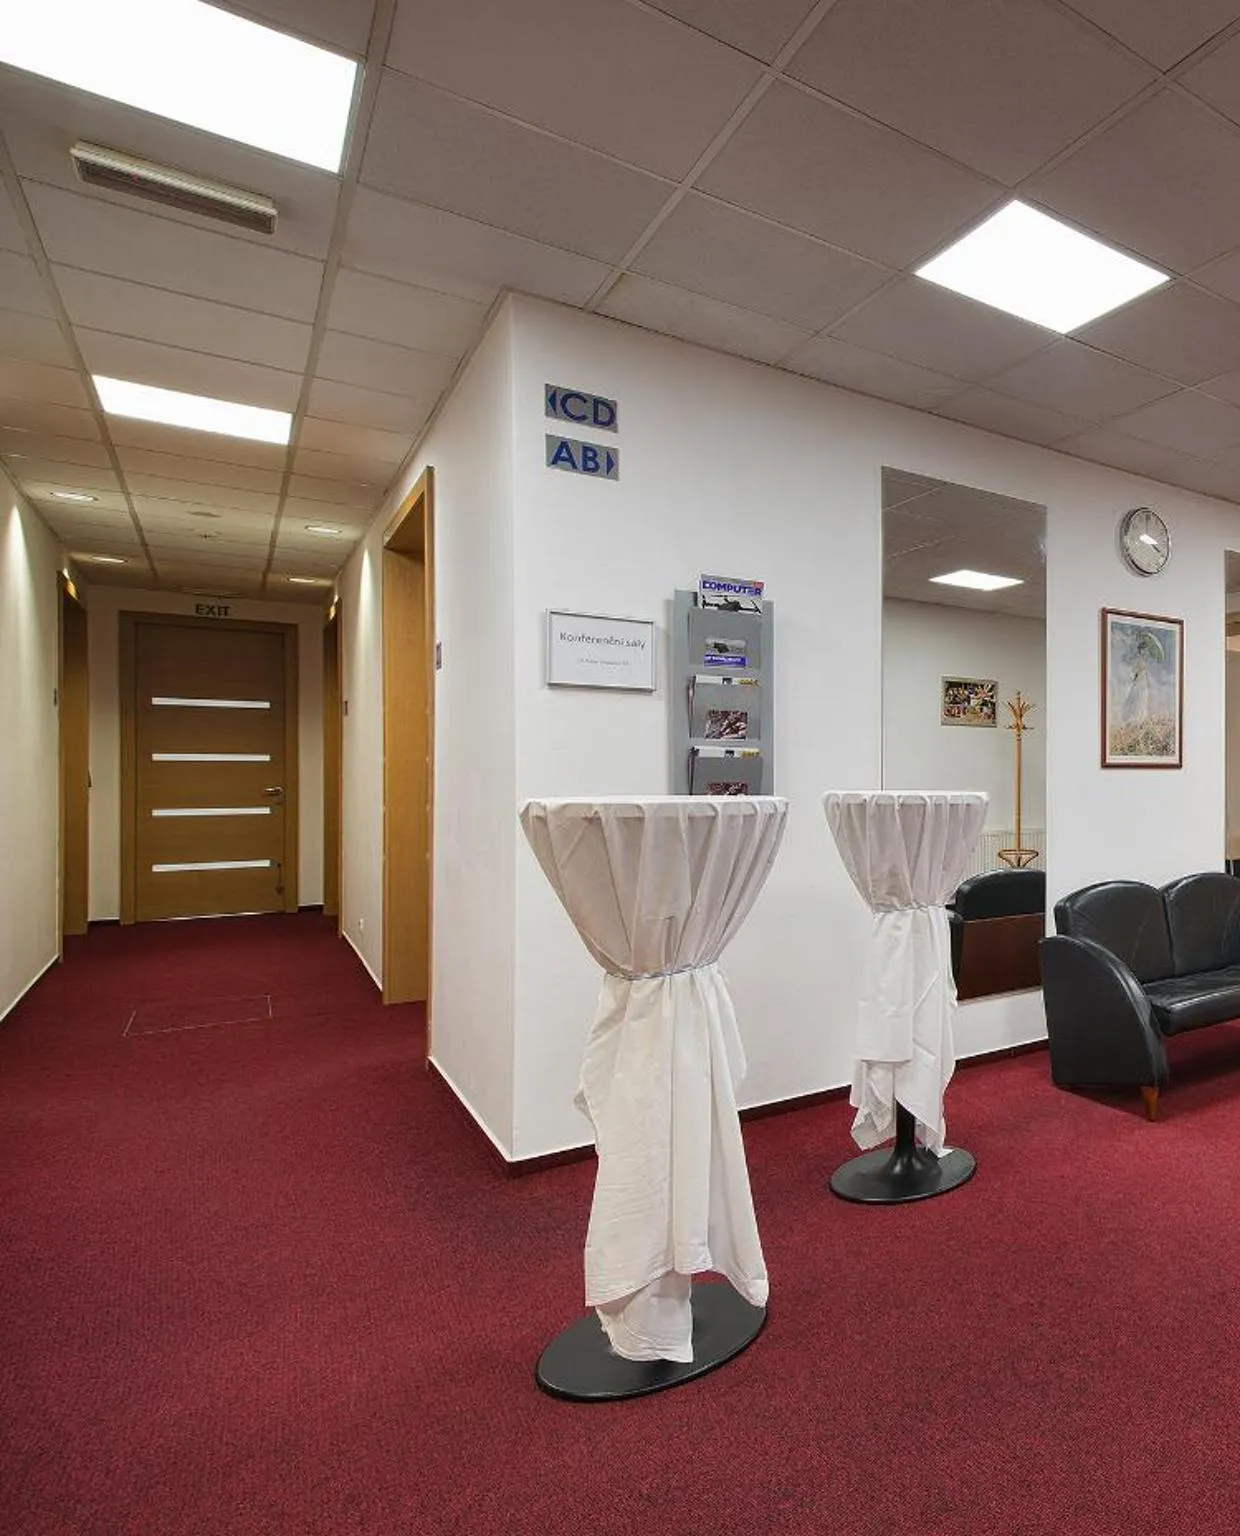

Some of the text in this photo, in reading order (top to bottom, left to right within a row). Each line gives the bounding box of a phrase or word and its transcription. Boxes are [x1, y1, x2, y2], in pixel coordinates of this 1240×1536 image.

[561, 393, 616, 427] CD
[551, 440, 600, 473] AB
[702, 580, 763, 597] COMPUTER
[195, 604, 230, 617] EXIT
